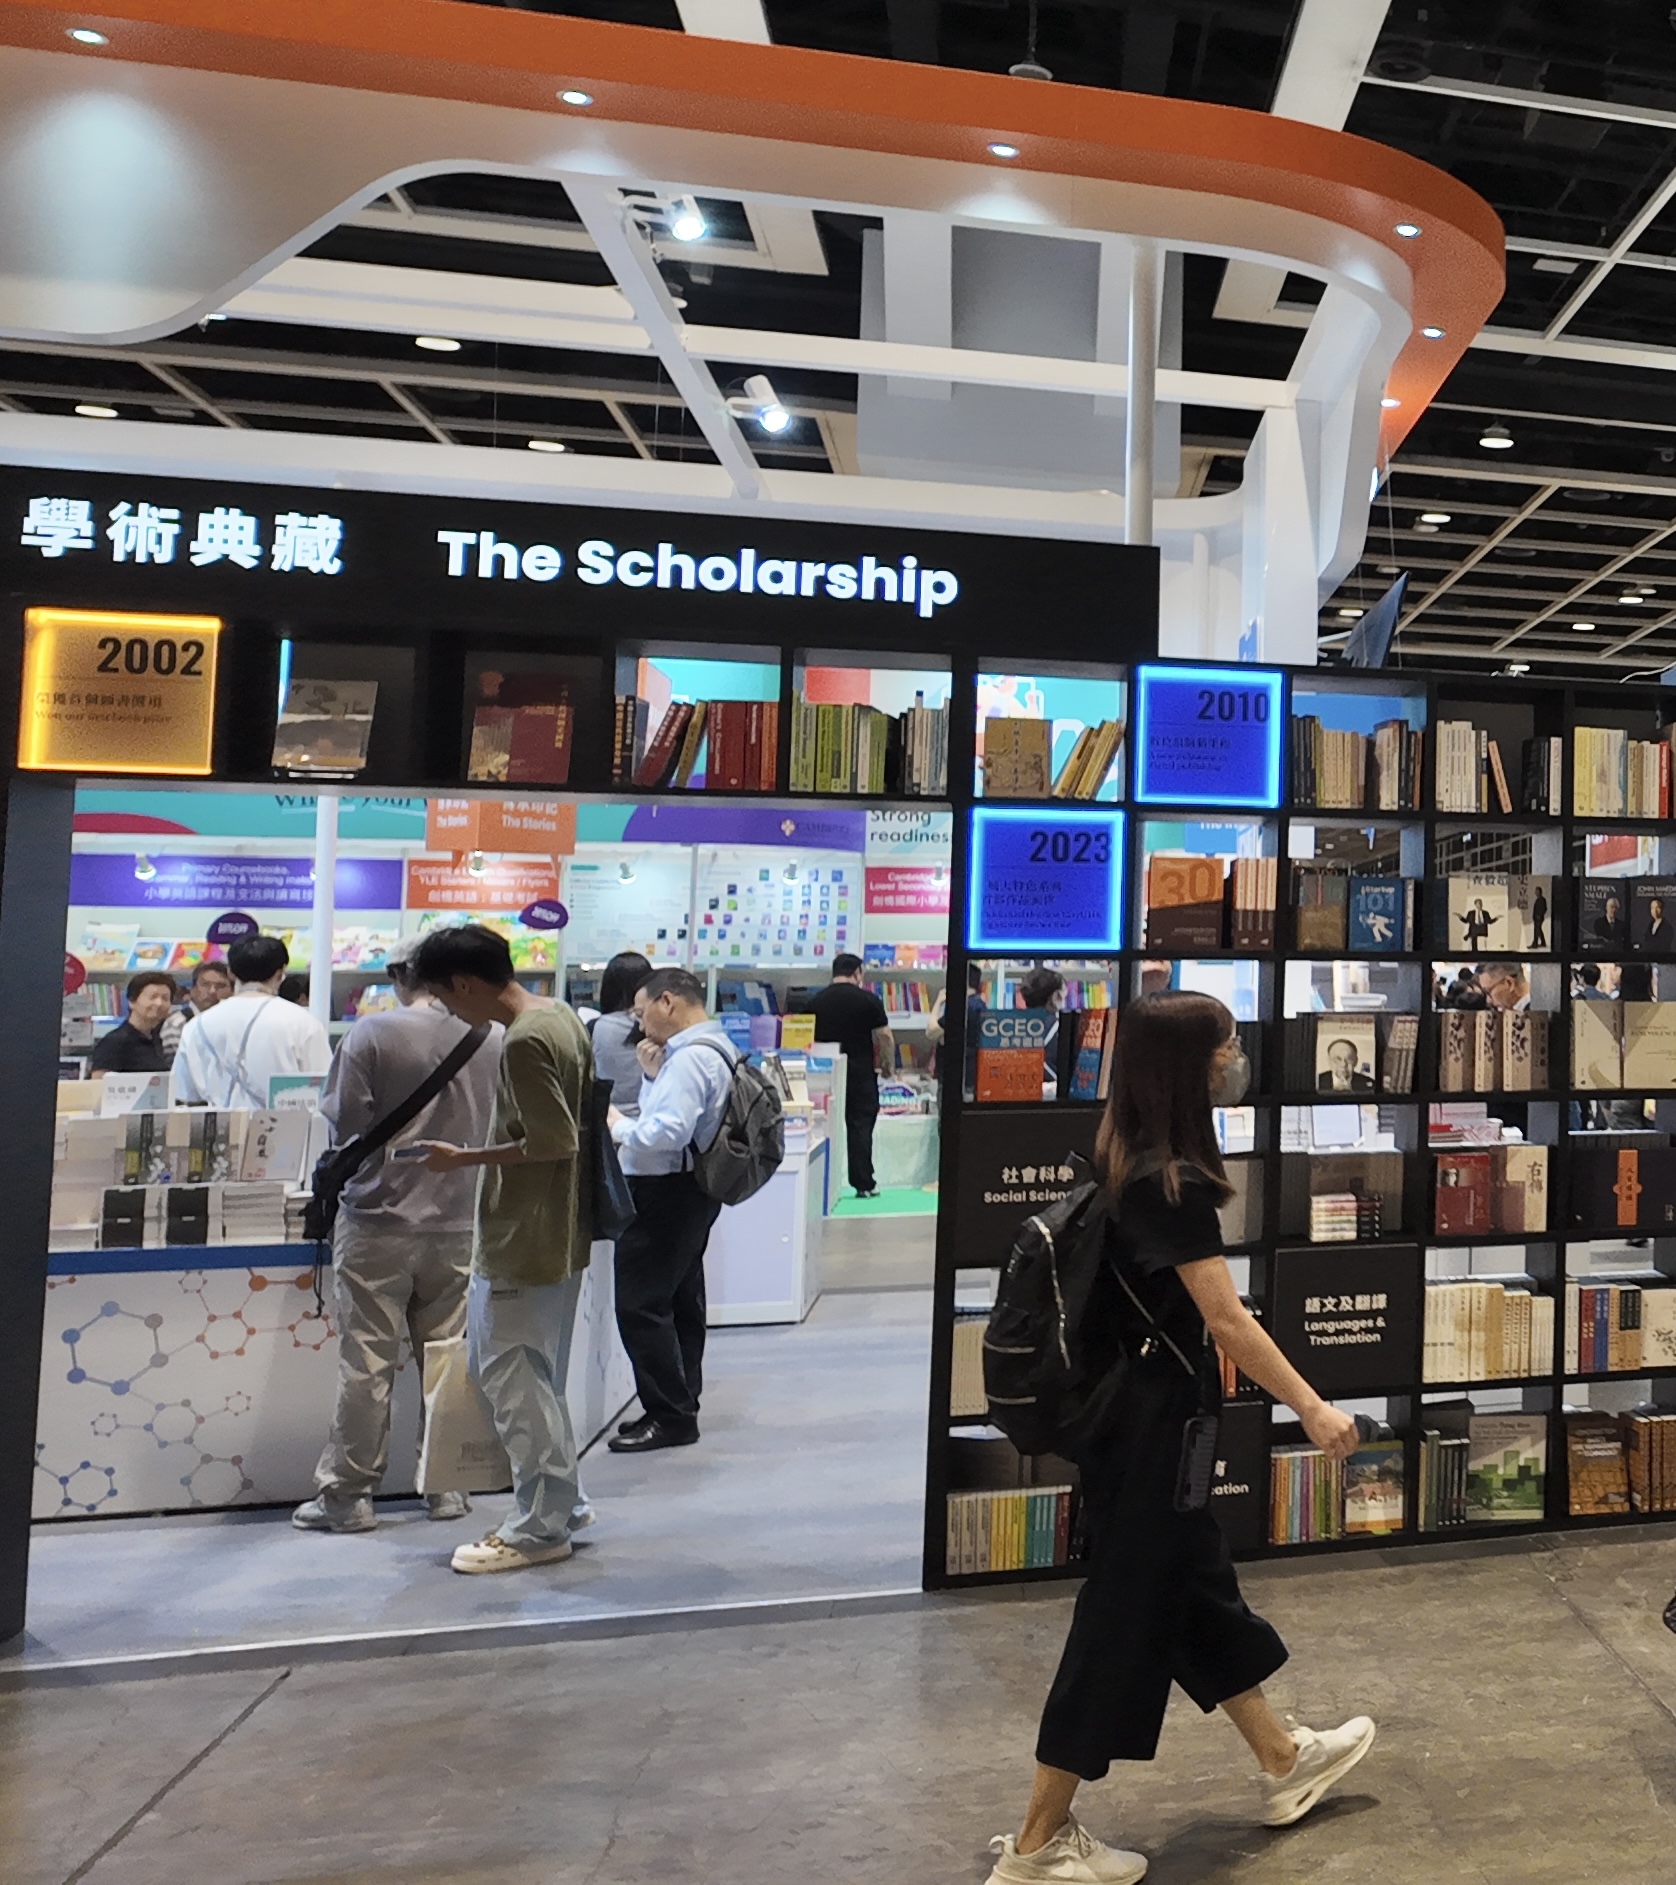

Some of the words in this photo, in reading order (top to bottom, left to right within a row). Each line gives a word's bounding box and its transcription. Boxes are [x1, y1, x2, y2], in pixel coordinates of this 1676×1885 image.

[20, 496, 345, 575] 學術典藏
[437, 530, 562, 582] The
[576, 540, 959, 617] Scholarship
[97, 636, 204, 676] 2002
[1197, 690, 1269, 722] 2010
[502, 815, 520, 827] The
[523, 816, 556, 831] Stories
[871, 811, 931, 827] Strong
[870, 828, 949, 843] readines
[1030, 831, 1112, 863] 2023
[1160, 862, 1217, 905] 30
[981, 1018, 1045, 1037] GCEO
[1002, 1165, 1075, 1184] 社會科學
[984, 1190, 1026, 1203] Social
[1305, 1293, 1387, 1313] 語文及翻譯
[1305, 1318, 1374, 1333] Languages
[1376, 1316, 1386, 1327] &
[1309, 1331, 1381, 1346] Translation
[1211, 1483, 1249, 1495] ation
